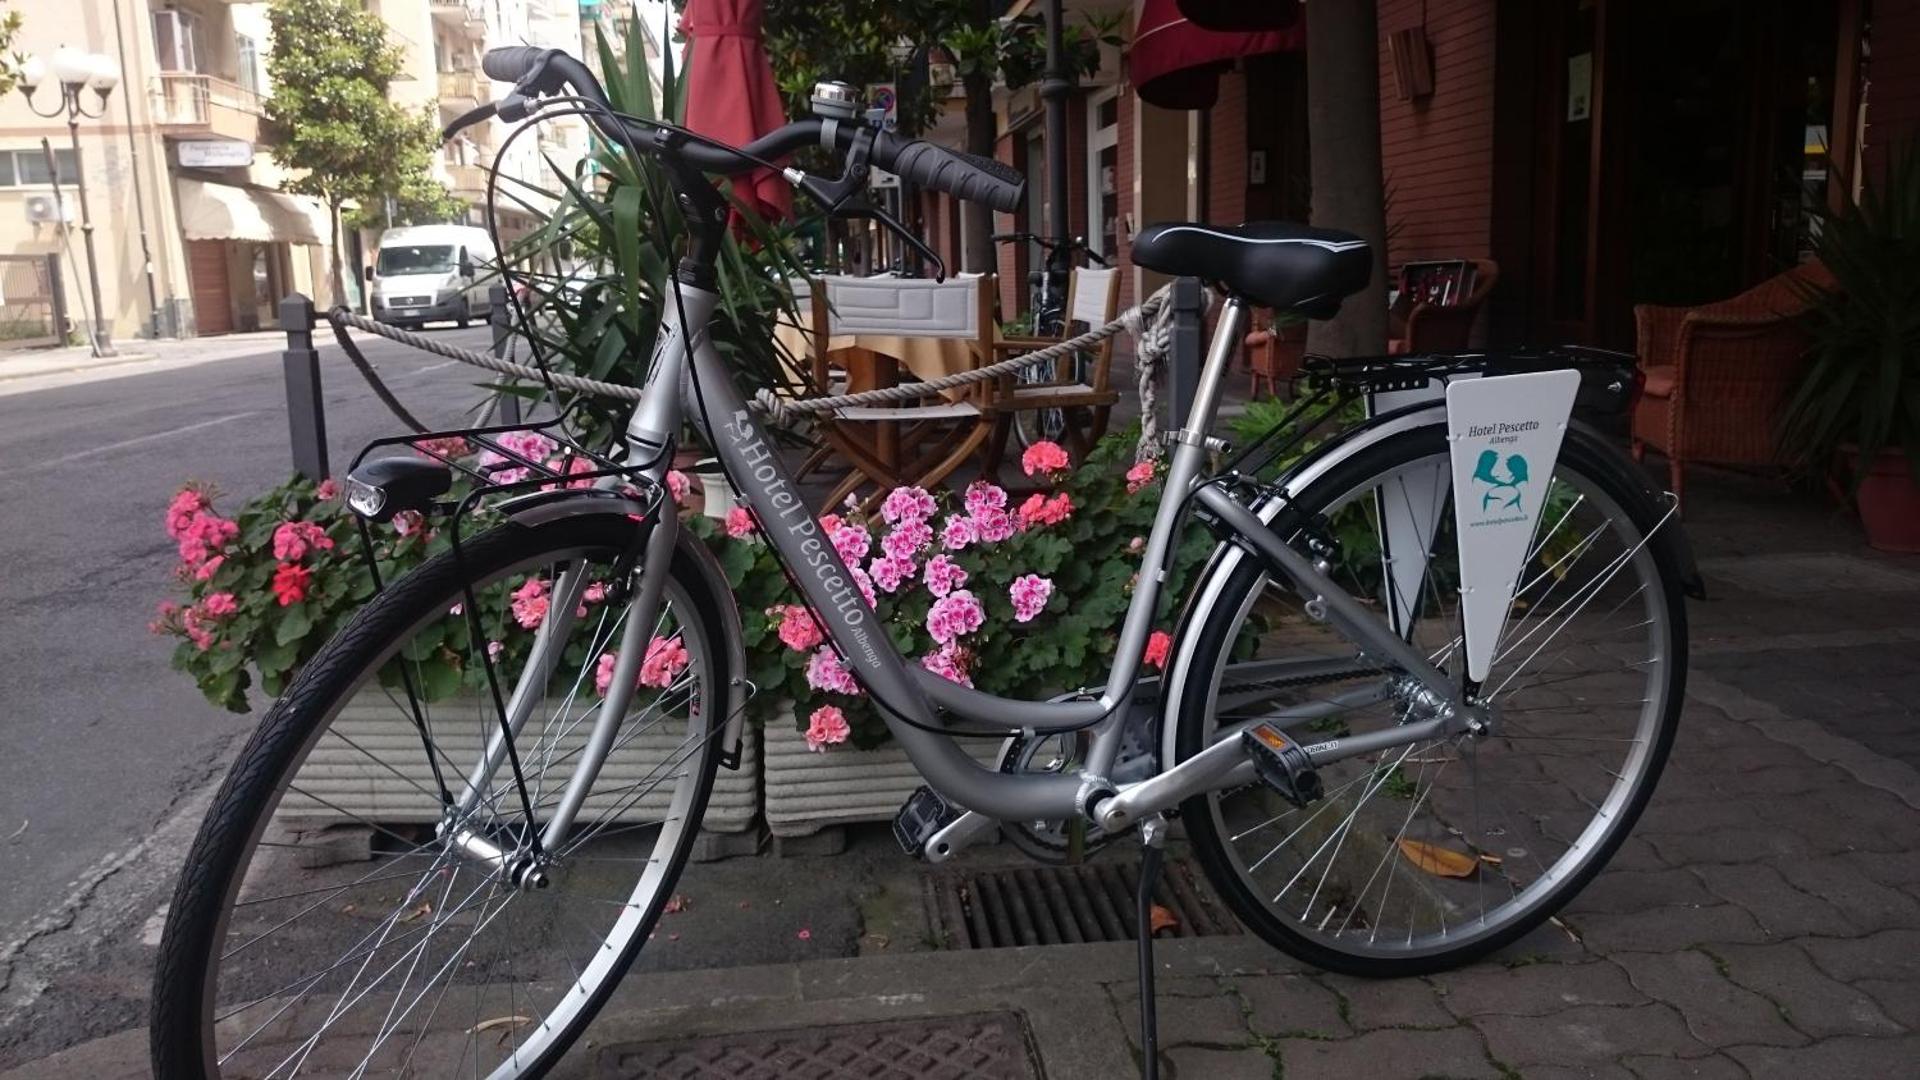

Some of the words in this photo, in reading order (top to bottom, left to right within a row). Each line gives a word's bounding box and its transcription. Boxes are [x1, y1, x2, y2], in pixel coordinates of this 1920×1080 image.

[1469, 424, 1496, 438] Hotel
[1498, 421, 1540, 434] Pescetto
[740, 438, 803, 519] Hotel
[788, 516, 864, 625] Pescetto
[850, 626, 882, 670] Albenga
